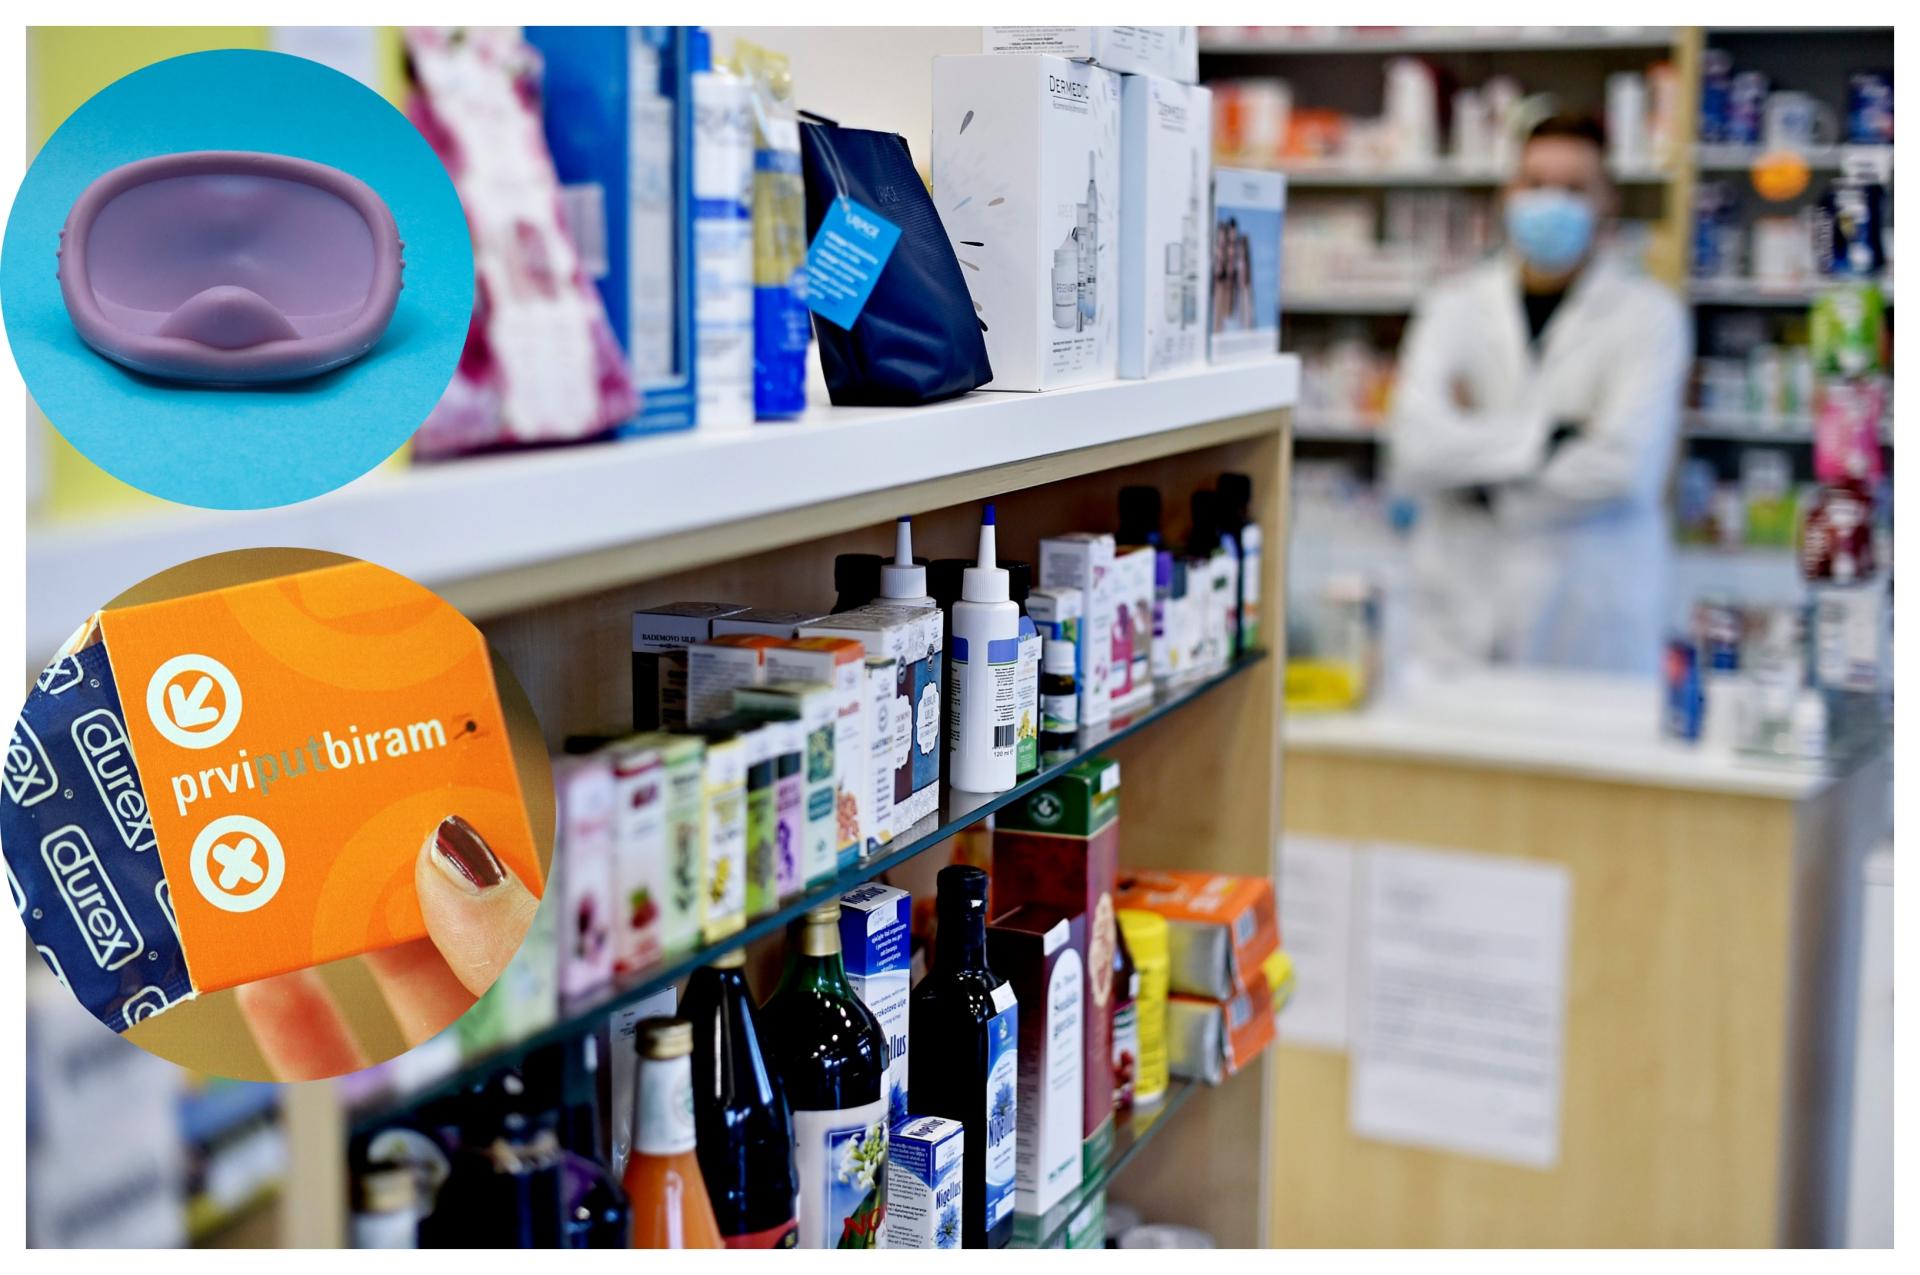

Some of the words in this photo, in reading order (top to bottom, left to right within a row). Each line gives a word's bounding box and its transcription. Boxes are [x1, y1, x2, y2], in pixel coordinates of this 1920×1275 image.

[1049, 75, 1089, 99] DERMEDIC
[642, 633, 679, 643] BADEMOVO
[994, 750, 1003, 758] 120
[82, 722, 153, 849] durex
[53, 840, 132, 968] durex
[889, 1034, 907, 1061] llus
[907, 1119, 946, 1137] Nigellus
[936, 1180, 961, 1209] Nigellus
